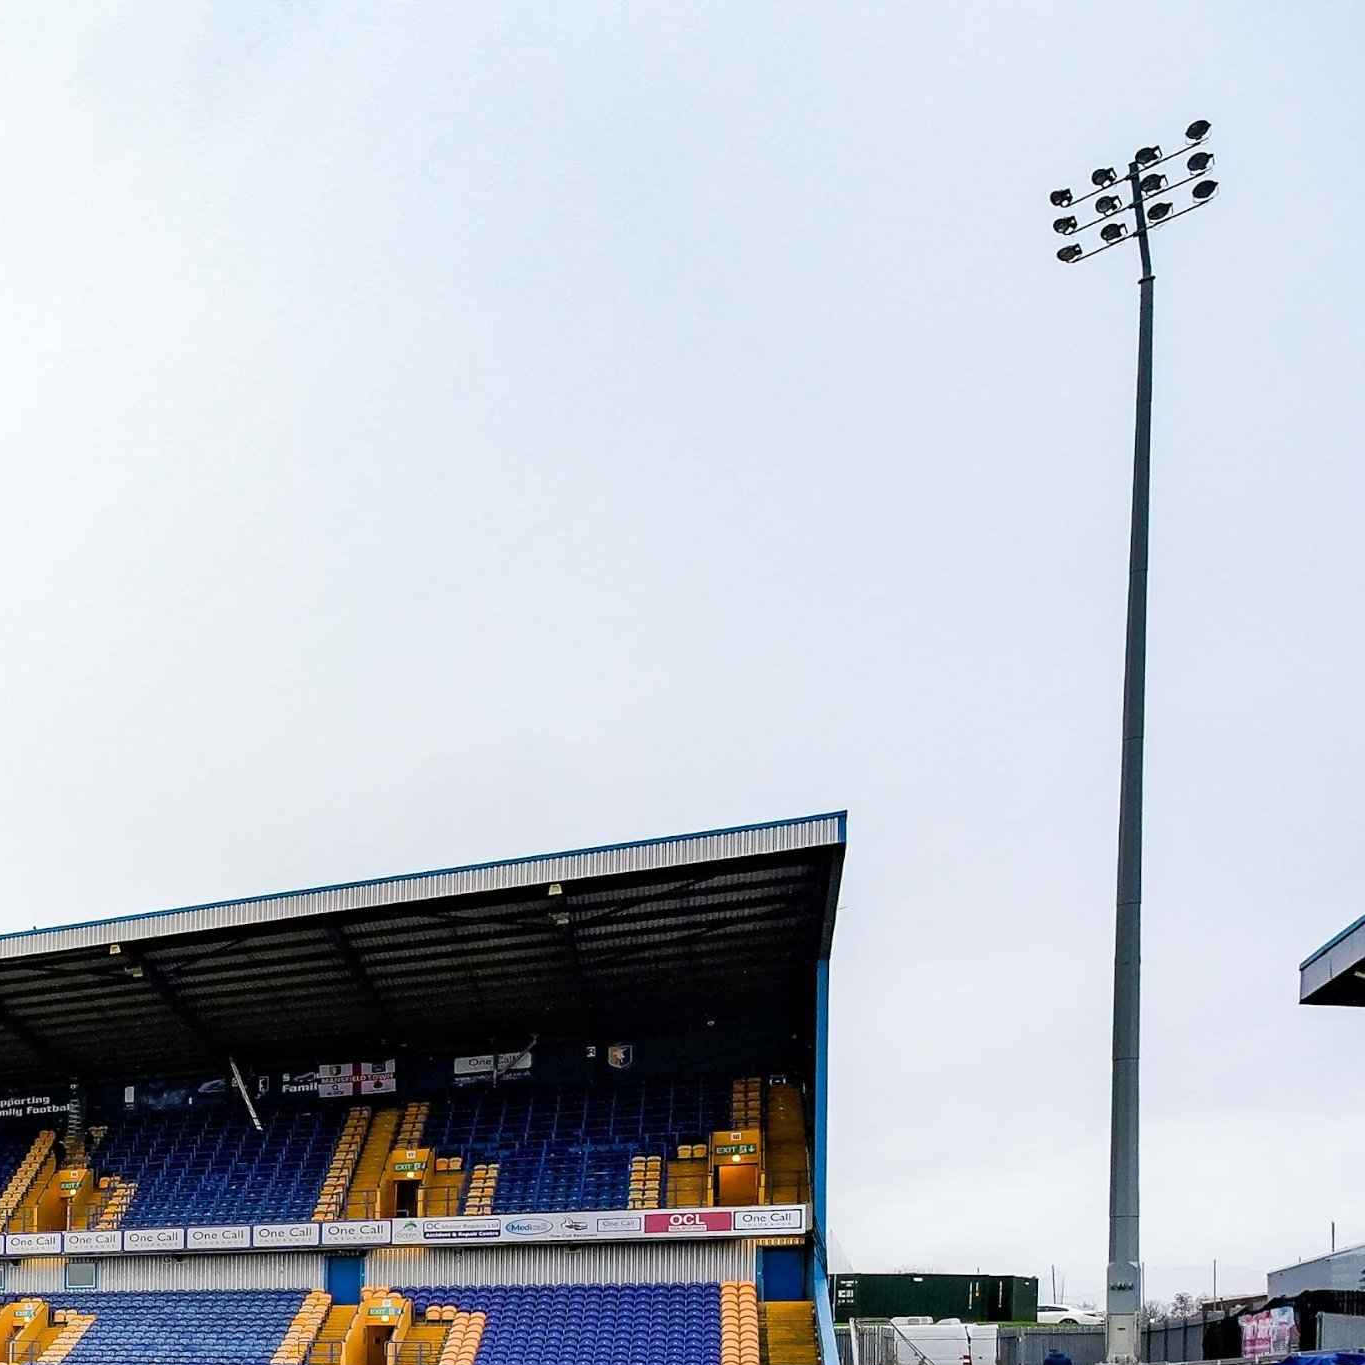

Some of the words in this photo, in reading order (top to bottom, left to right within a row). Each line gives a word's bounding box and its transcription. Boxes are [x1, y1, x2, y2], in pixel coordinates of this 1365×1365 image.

[468, 1058, 492, 1067] One
[321, 1075, 367, 1084] MANSFIELD
[368, 1072, 393, 1081] TOWN
[282, 1082, 318, 1093] Famil
[716, 1146, 738, 1155] EXIT
[669, 1214, 706, 1225] OCL
[742, 1214, 766, 1222] One
[770, 1212, 792, 1221] Call
[328, 1225, 355, 1235] One
[360, 1225, 384, 1234] Call
[426, 1222, 440, 1230] OC
[129, 1233, 153, 1242] One
[157, 1233, 178, 1241] Call
[193, 1231, 218, 1240] One
[222, 1230, 244, 1239] Call
[259, 1228, 285, 1238] One
[289, 1227, 312, 1237] Call
[11, 1237, 33, 1246] One
[36, 1236, 56, 1246] Call
[69, 1235, 91, 1244] One
[95, 1235, 116, 1243] Call
